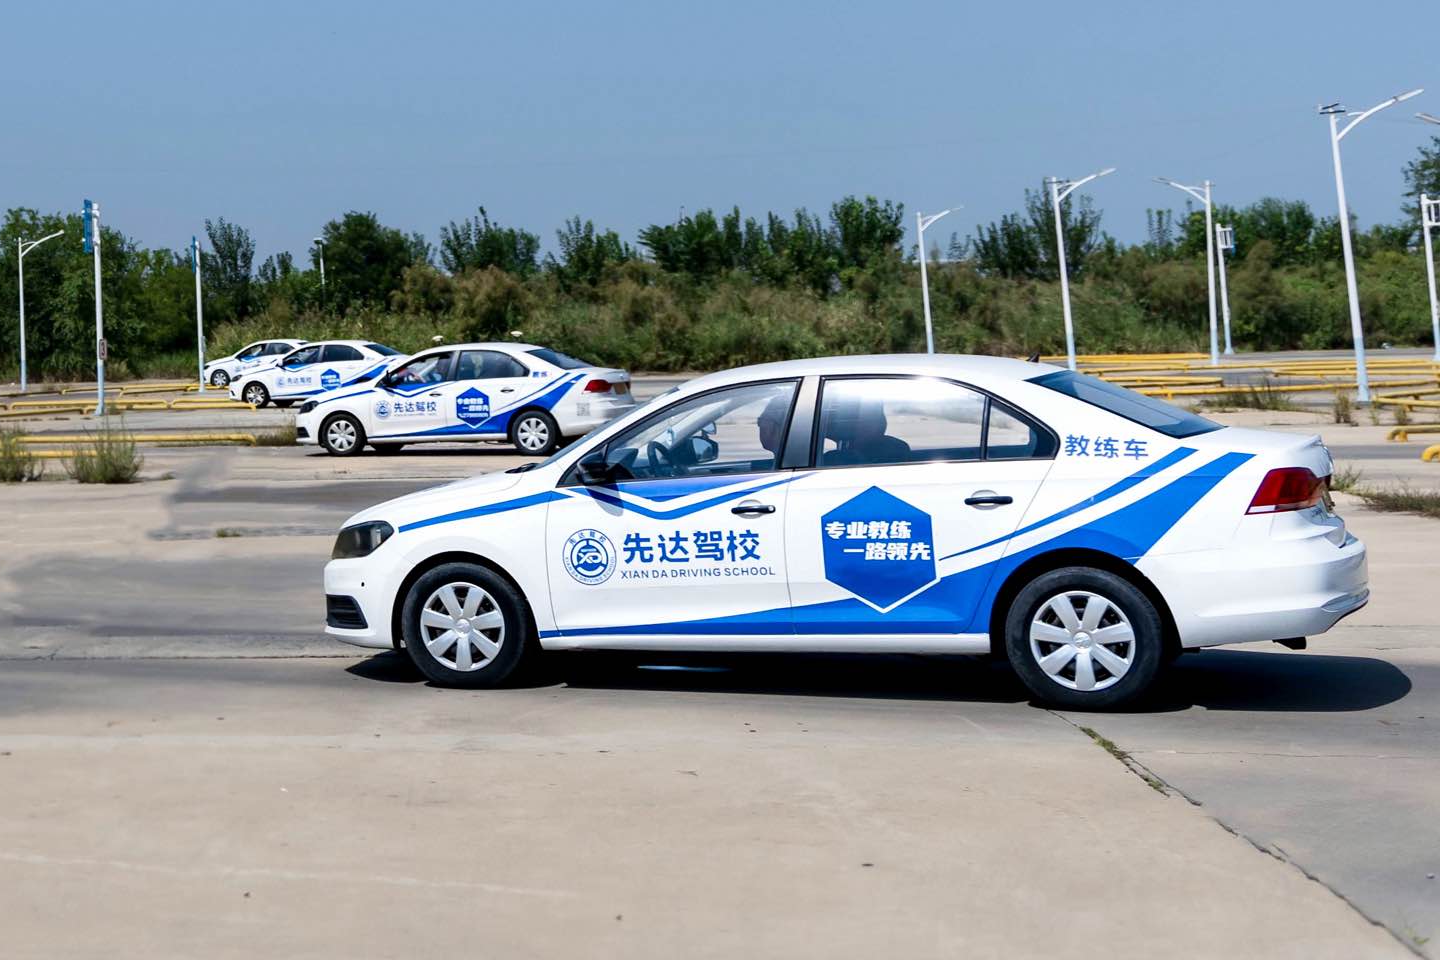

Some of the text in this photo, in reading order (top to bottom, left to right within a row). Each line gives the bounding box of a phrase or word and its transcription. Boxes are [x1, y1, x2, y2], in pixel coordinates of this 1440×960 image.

[1064, 434, 1150, 460] 教练车
[824, 520, 912, 540] 专业教练
[622, 529, 761, 565] 先达驾校
[843, 542, 931, 561] 一路领先
[620, 566, 776, 580] XIAN DA DRIVING SCHOOL
